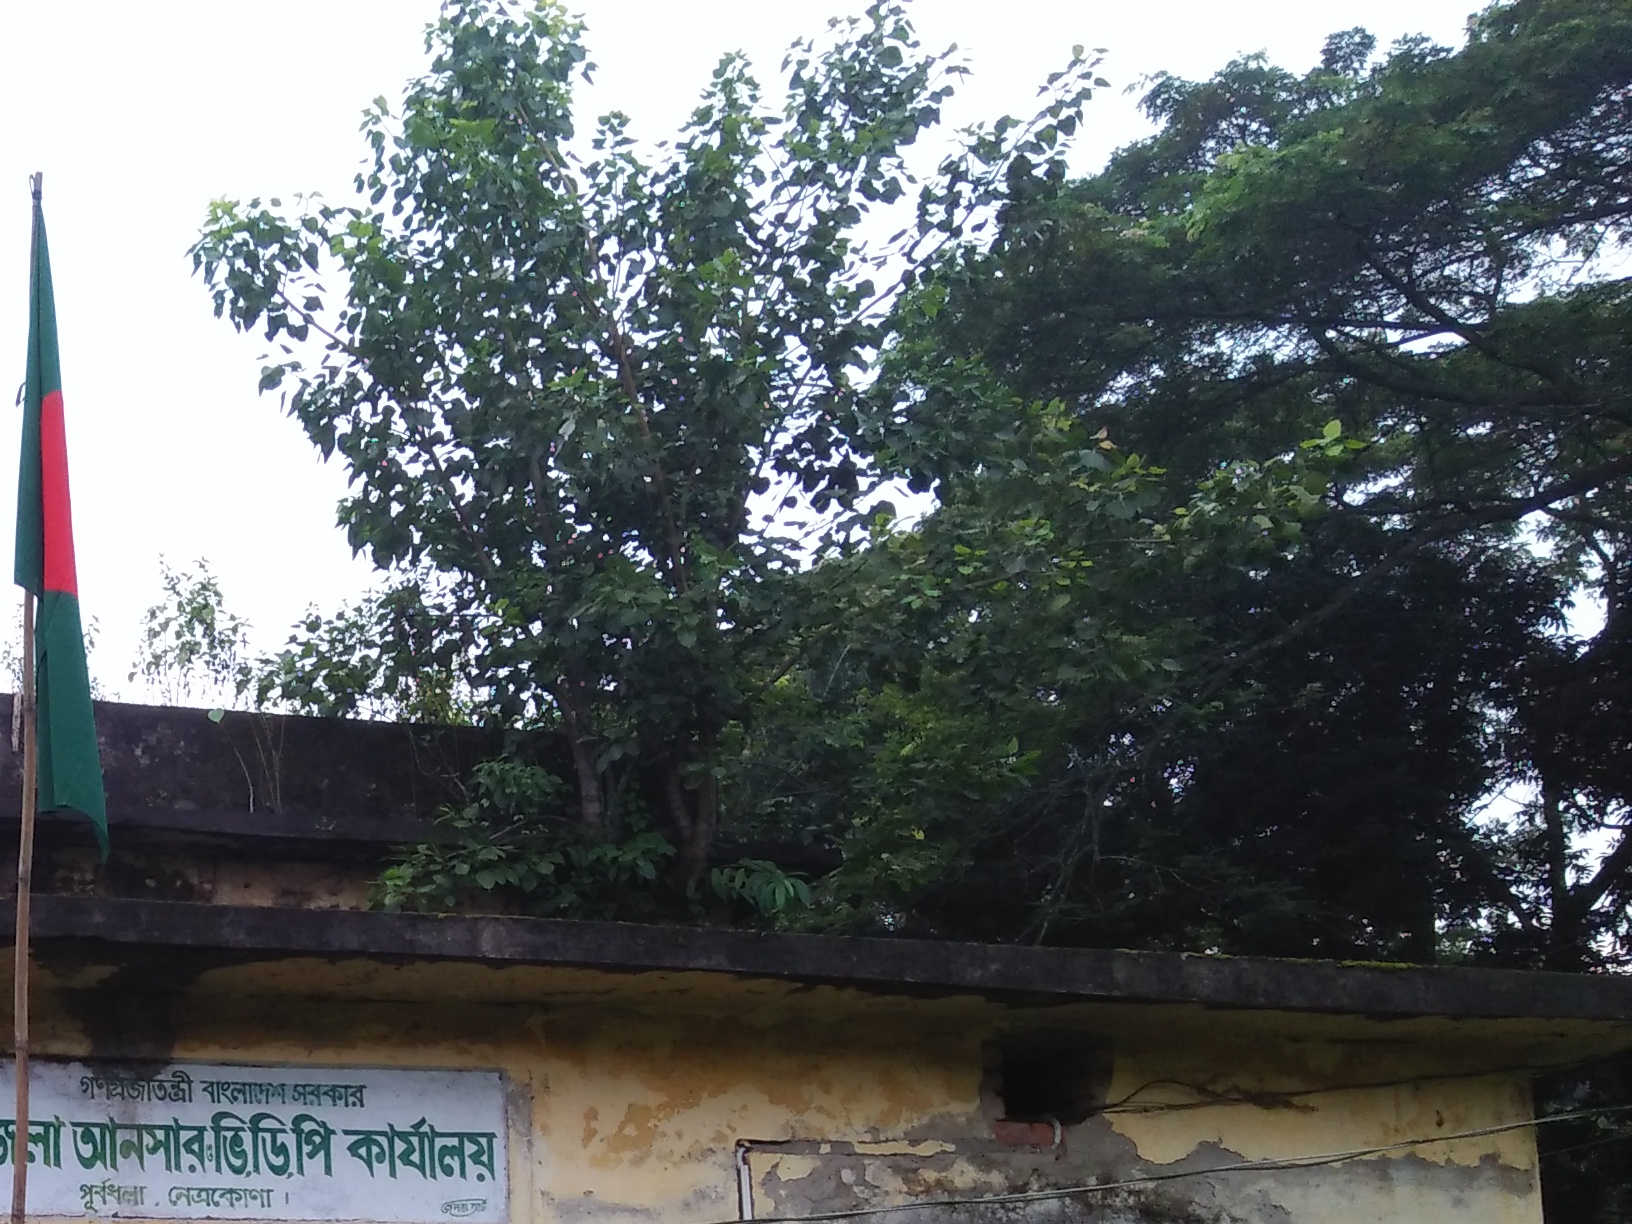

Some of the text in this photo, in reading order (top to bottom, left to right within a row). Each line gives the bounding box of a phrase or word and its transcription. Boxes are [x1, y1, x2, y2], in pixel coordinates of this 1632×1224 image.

[292, 1083, 366, 1108] সরকার
[70, 1115, 206, 1173] আনসার
[341, 1116, 498, 1182] কার্যালয়
